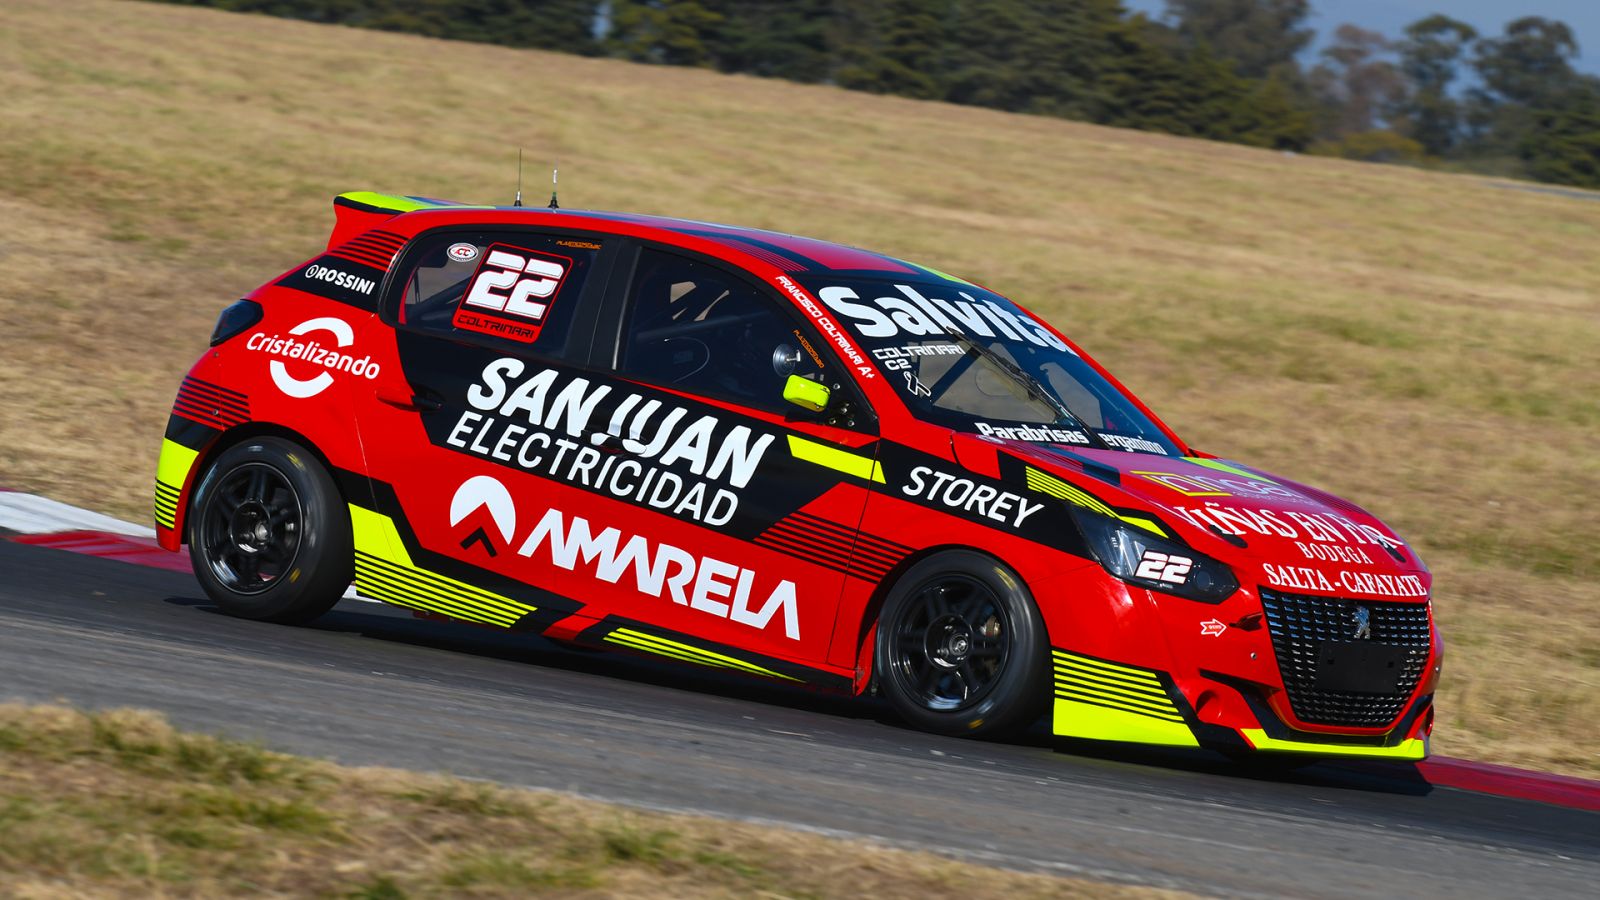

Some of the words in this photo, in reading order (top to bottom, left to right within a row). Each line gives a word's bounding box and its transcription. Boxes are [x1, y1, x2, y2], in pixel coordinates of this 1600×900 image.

[314, 267, 375, 295] ROSSINI
[465, 249, 564, 320] 22
[457, 315, 535, 339] COLTRINARI
[775, 275, 823, 318] FRANCISCO
[817, 317, 865, 365] COLTRINARI
[818, 284, 1081, 358] Salvita
[246, 332, 380, 379] Cristalizando
[872, 344, 966, 360] COLTRINARI
[884, 358, 912, 371] C2
[467, 357, 612, 438] SAN
[590, 392, 776, 488] JUAN
[974, 422, 1090, 444] Parabrisas
[1098, 432, 1168, 456] ergamino
[446, 411, 739, 526] ELECTRICIDAD
[902, 466, 1044, 528] STOREY
[1150, 501, 1299, 538] VIÑAS
[1283, 510, 1348, 543] EN
[517, 508, 801, 641] AMARELA
[1135, 550, 1193, 585] 22
[1294, 541, 1374, 565] BODEGA
